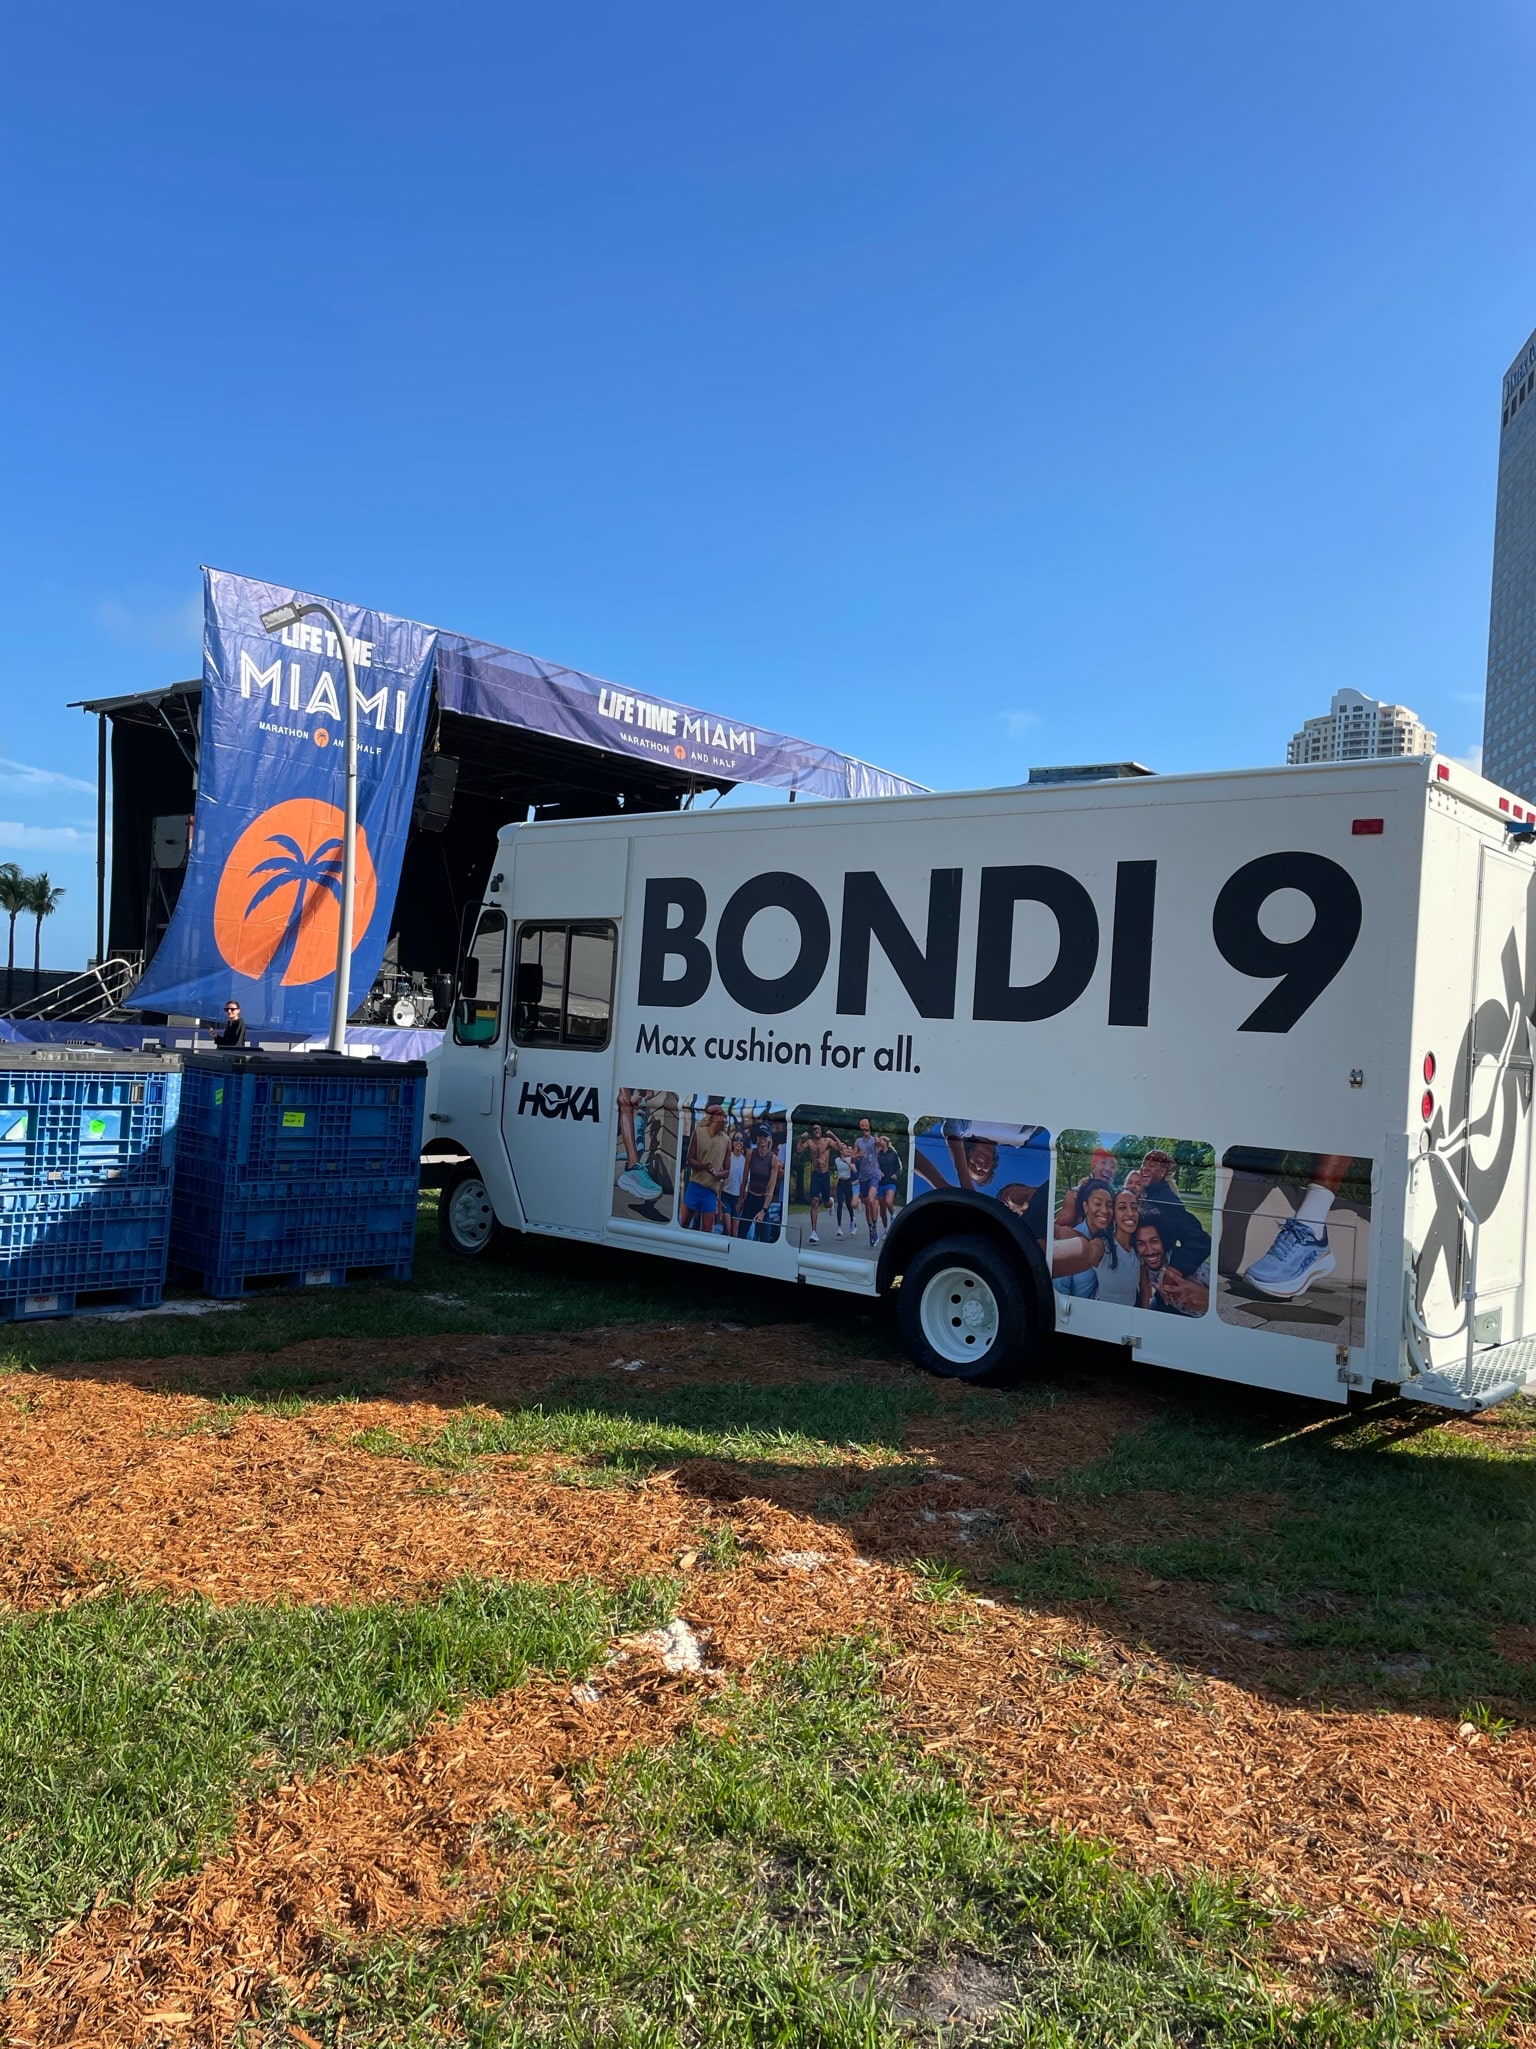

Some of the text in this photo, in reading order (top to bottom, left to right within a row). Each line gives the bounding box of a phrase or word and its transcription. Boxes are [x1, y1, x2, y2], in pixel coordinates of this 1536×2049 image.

[282, 622, 323, 655] LIFE
[240, 649, 406, 734] MIAMI
[259, 721, 309, 739] MARATHON
[598, 688, 756, 756] LIFE TIME MIAMI
[333, 738, 382, 755] AN HALF
[619, 731, 736, 769] MARATHON AND HALF
[637, 850, 1363, 1034] BONDI 9
[635, 1024, 921, 1074] Max cushion for all.
[517, 1081, 600, 1123] HOKA
